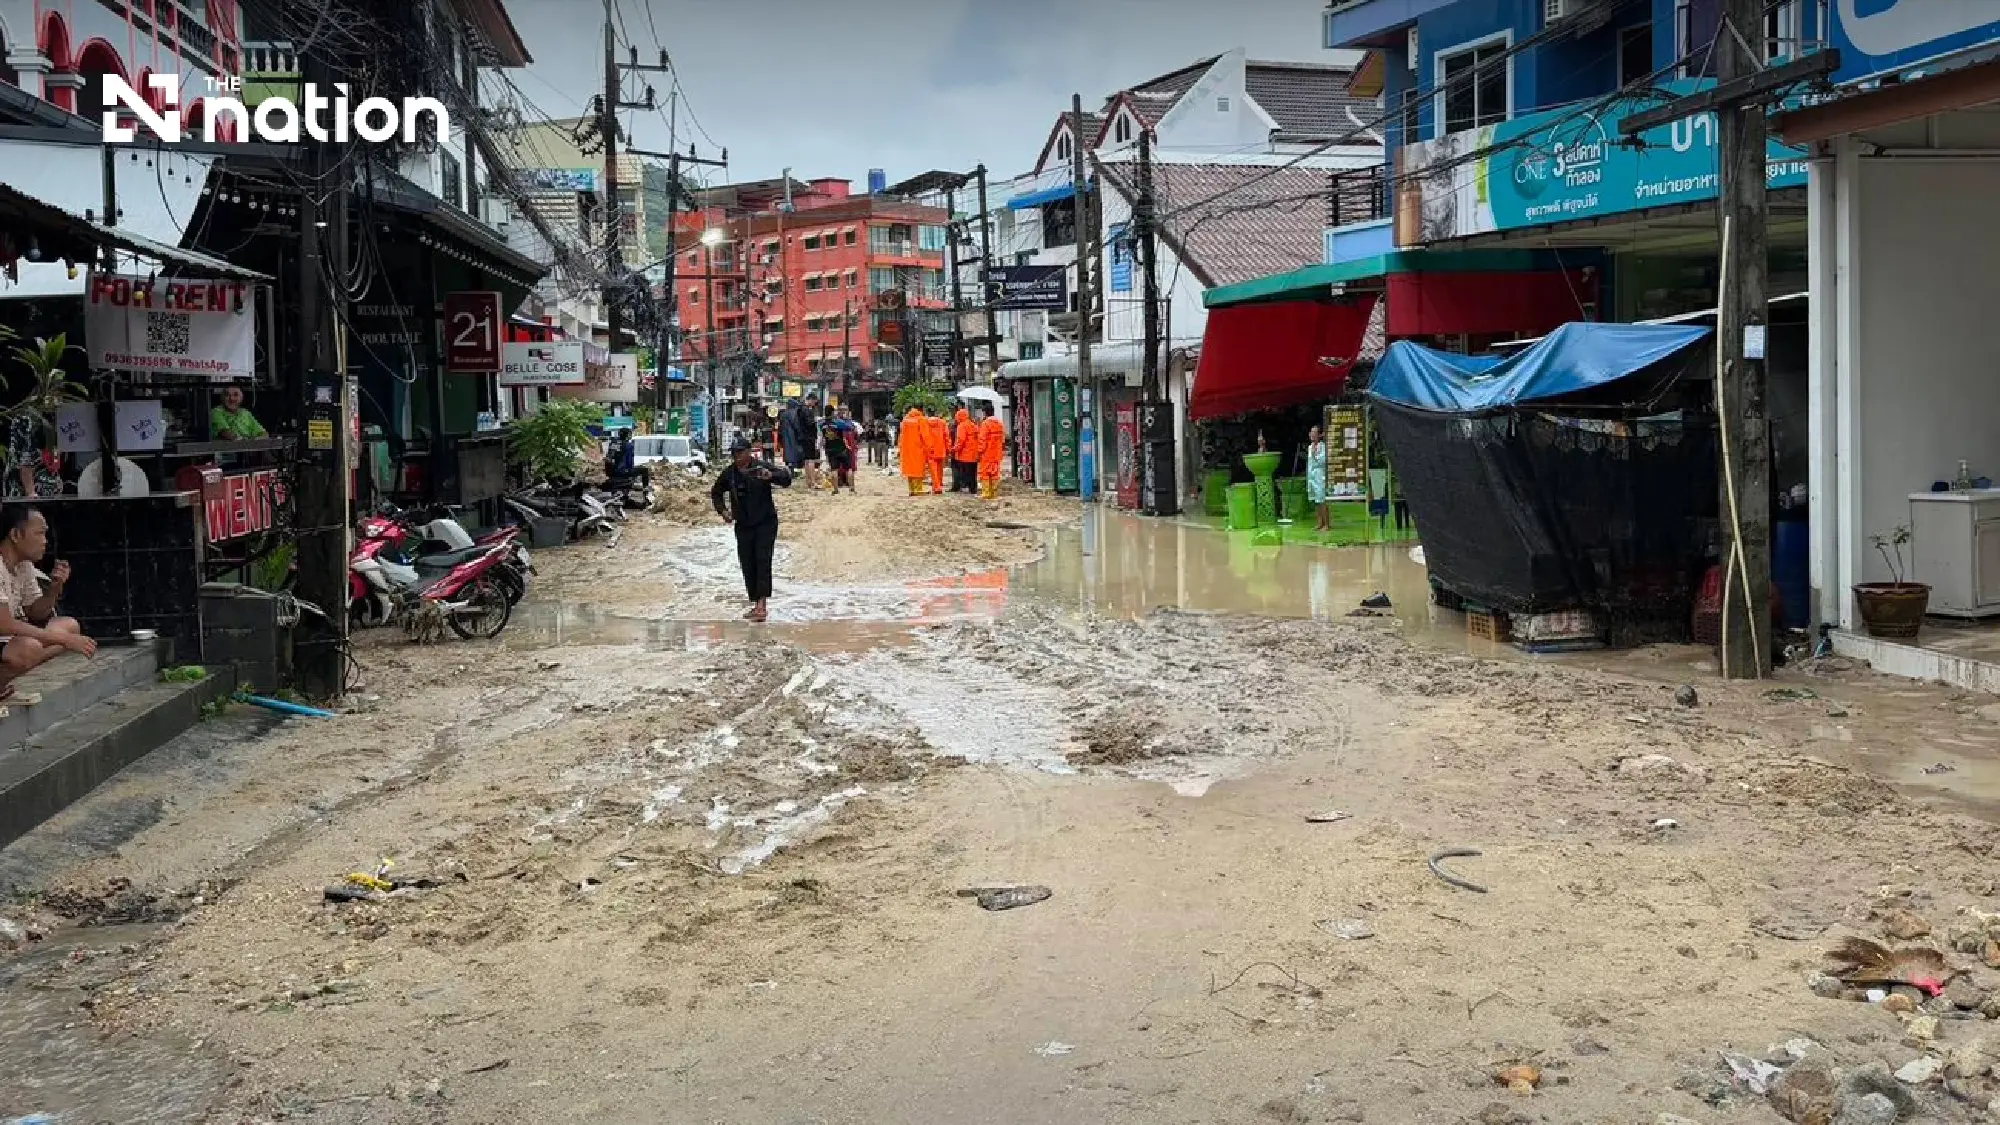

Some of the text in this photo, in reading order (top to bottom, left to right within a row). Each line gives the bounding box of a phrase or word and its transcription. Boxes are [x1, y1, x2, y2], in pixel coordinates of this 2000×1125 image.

[91, 277, 247, 313] FOR RENT
[177, 359, 230, 372] WhatsApp
[505, 362, 578, 373] BELLE COSE
